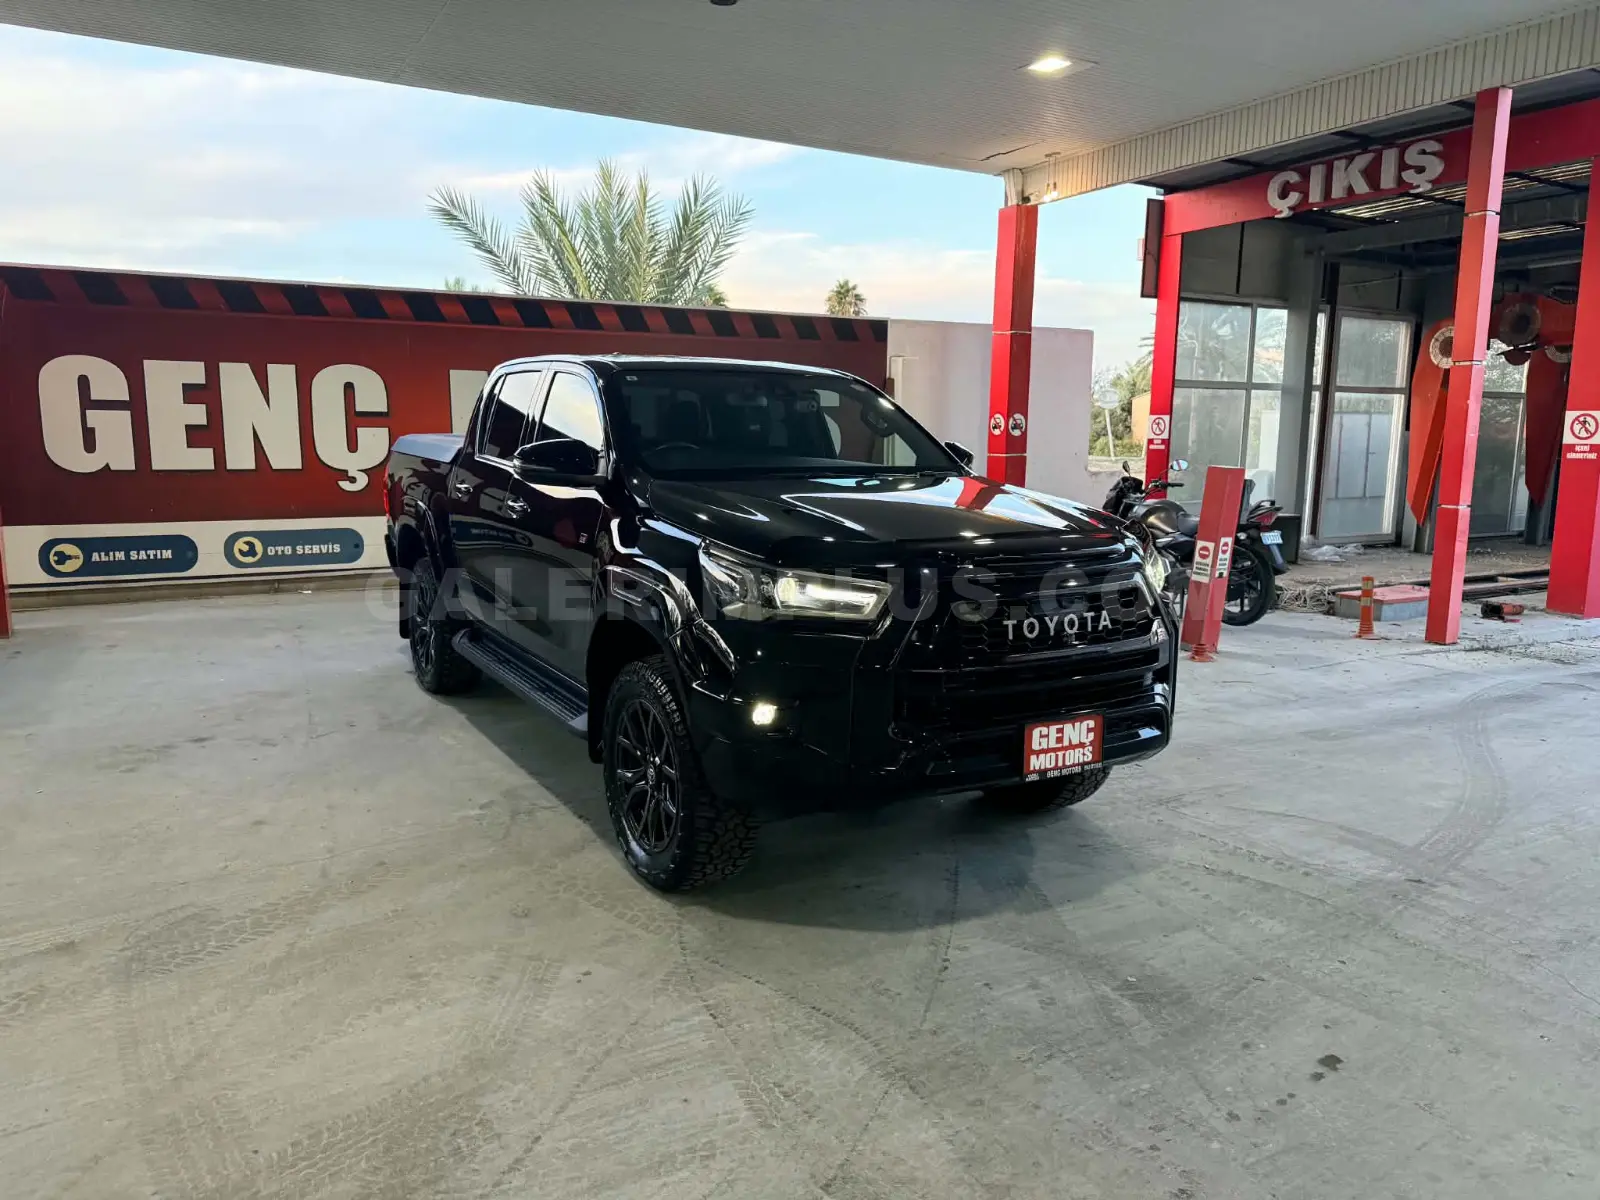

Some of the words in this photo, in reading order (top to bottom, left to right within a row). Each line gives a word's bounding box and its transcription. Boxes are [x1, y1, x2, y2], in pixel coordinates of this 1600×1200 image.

[1267, 139, 1445, 219] ÇIKIŞ
[38, 354, 391, 492] GENÇ
[91, 551, 126, 562] ALIM
[130, 549, 173, 560] SATIM
[267, 545, 293, 555] OTO
[296, 541, 341, 555] SERVİS
[1003, 609, 1112, 641] TOYOTA
[1031, 719, 1095, 751] GENÇ
[1029, 746, 1093, 771] MOTORS
